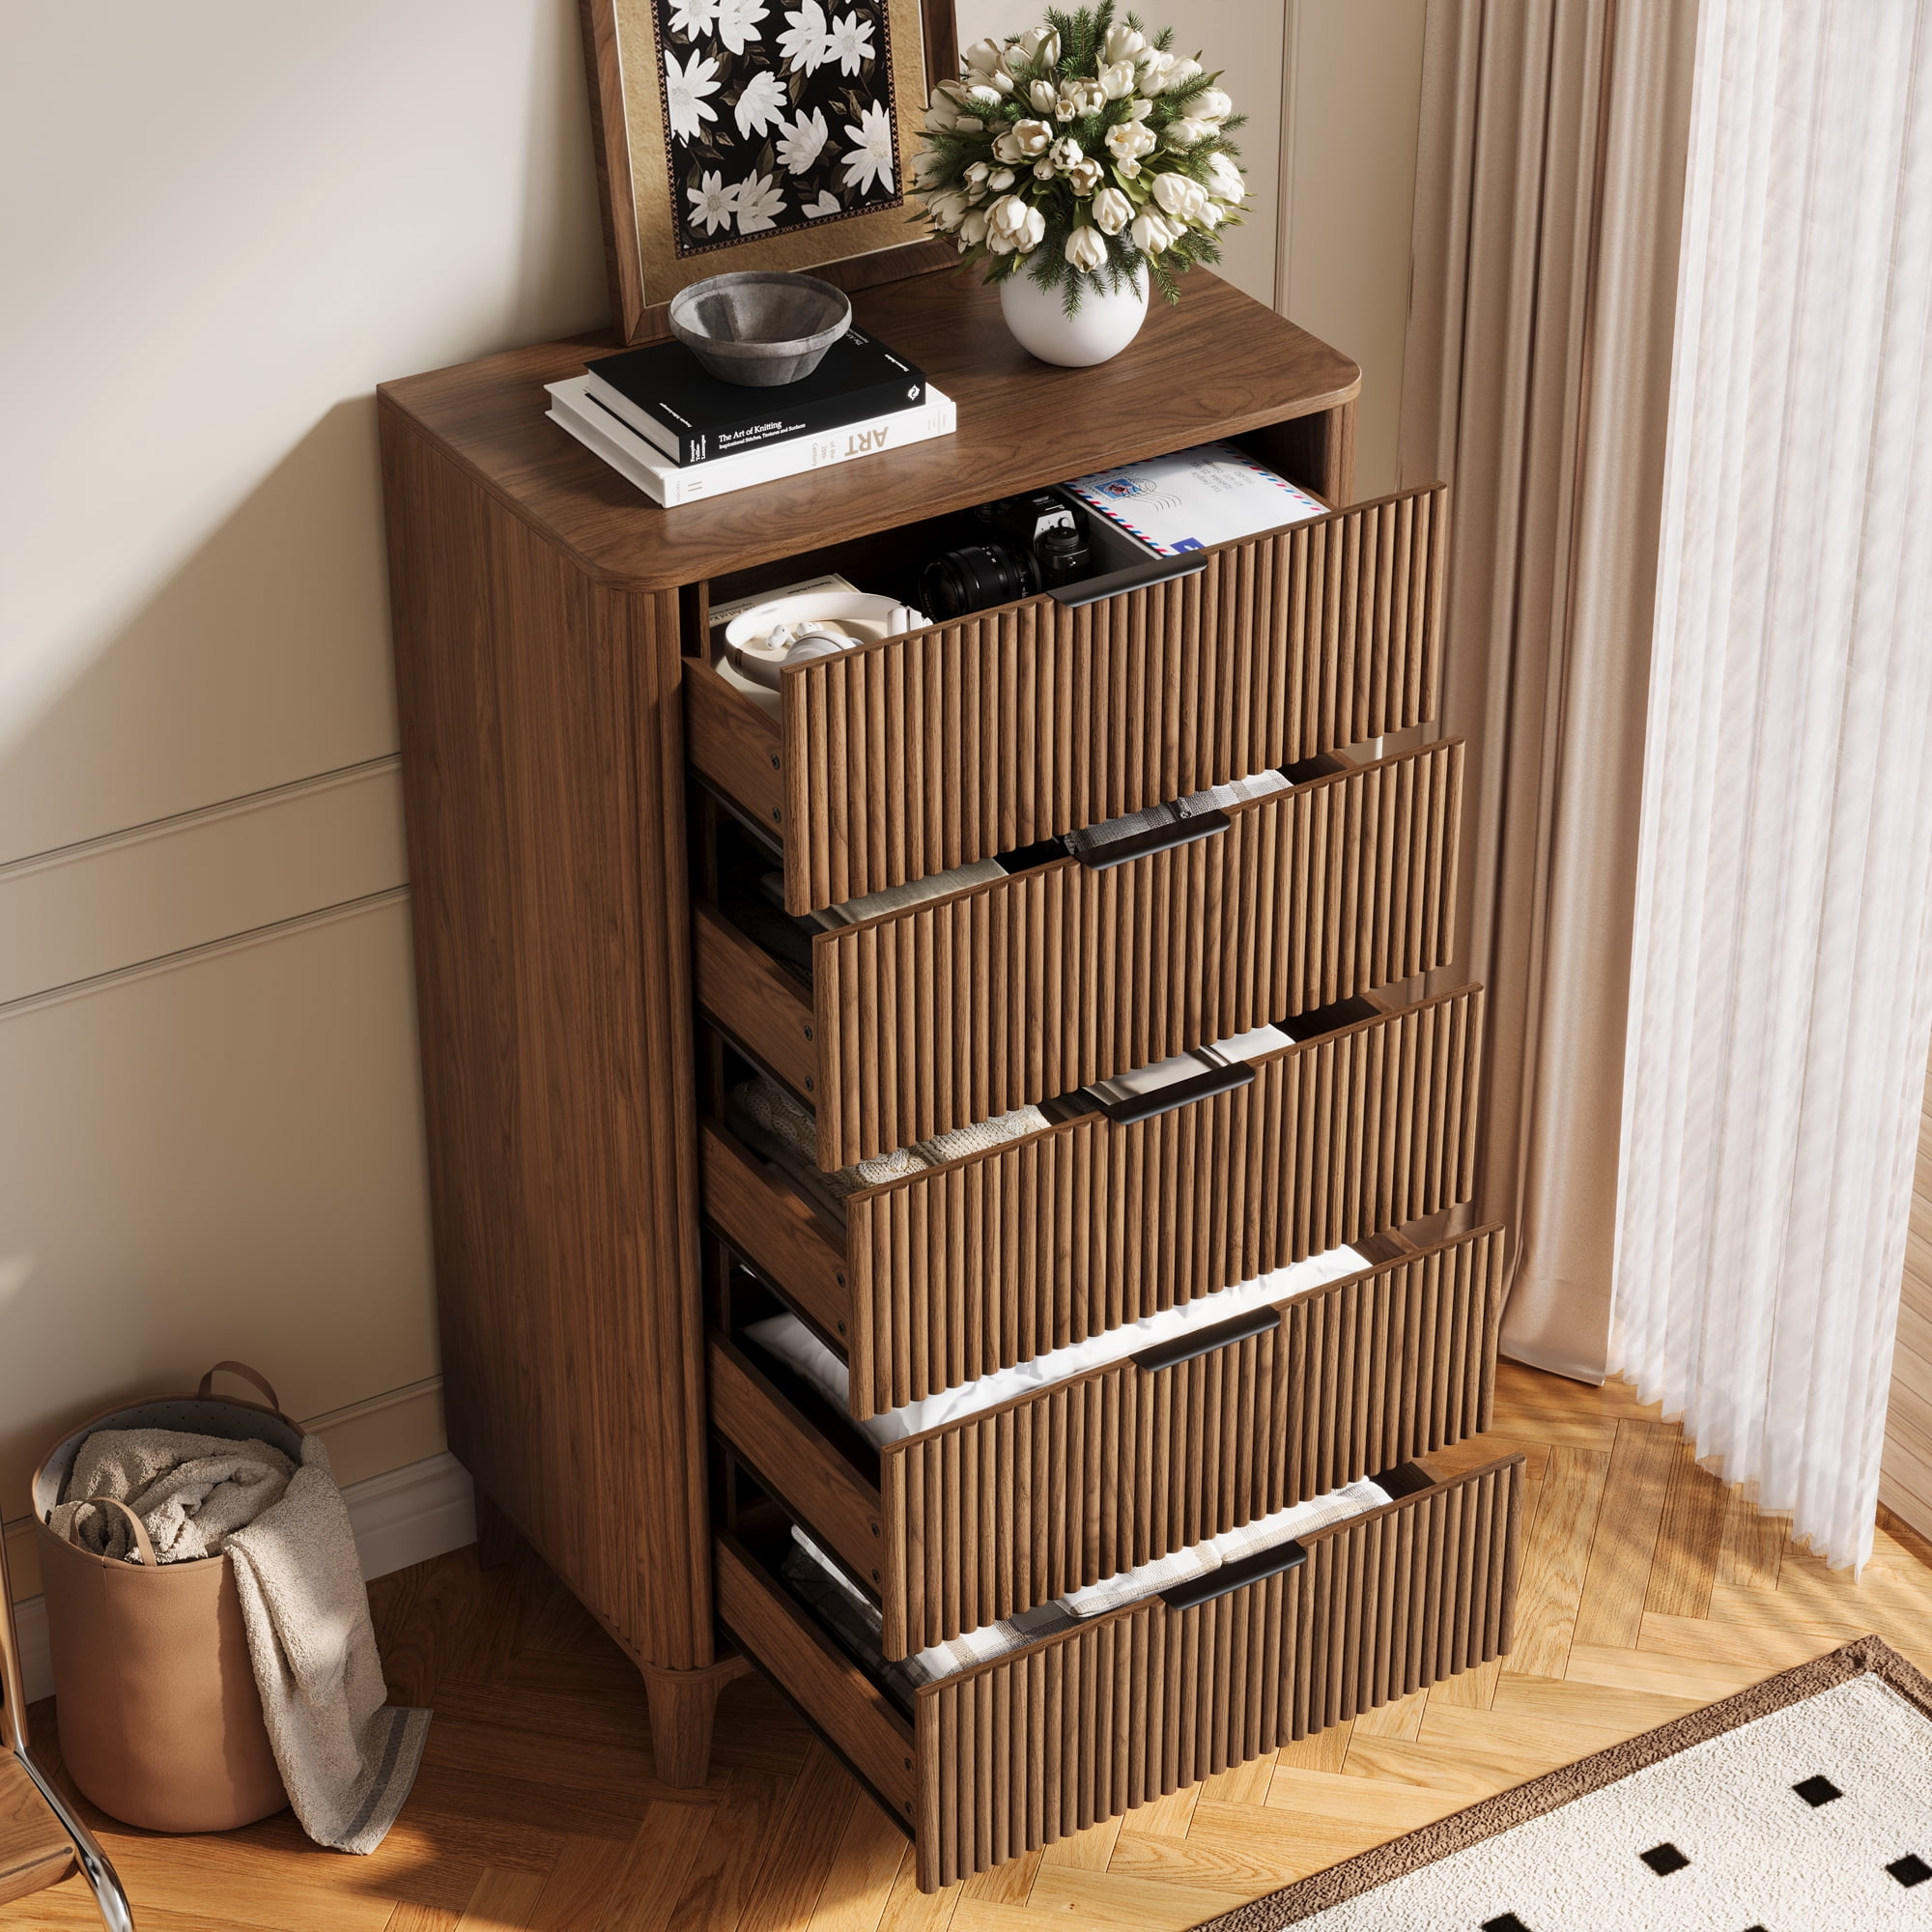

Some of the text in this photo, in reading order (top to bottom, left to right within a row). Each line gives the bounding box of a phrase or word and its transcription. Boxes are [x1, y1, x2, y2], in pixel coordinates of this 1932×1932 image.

[719, 434, 732, 442] The
[746, 427, 753, 436] of
[754, 421, 782, 434] Knitting
[844, 426, 889, 456] ART
